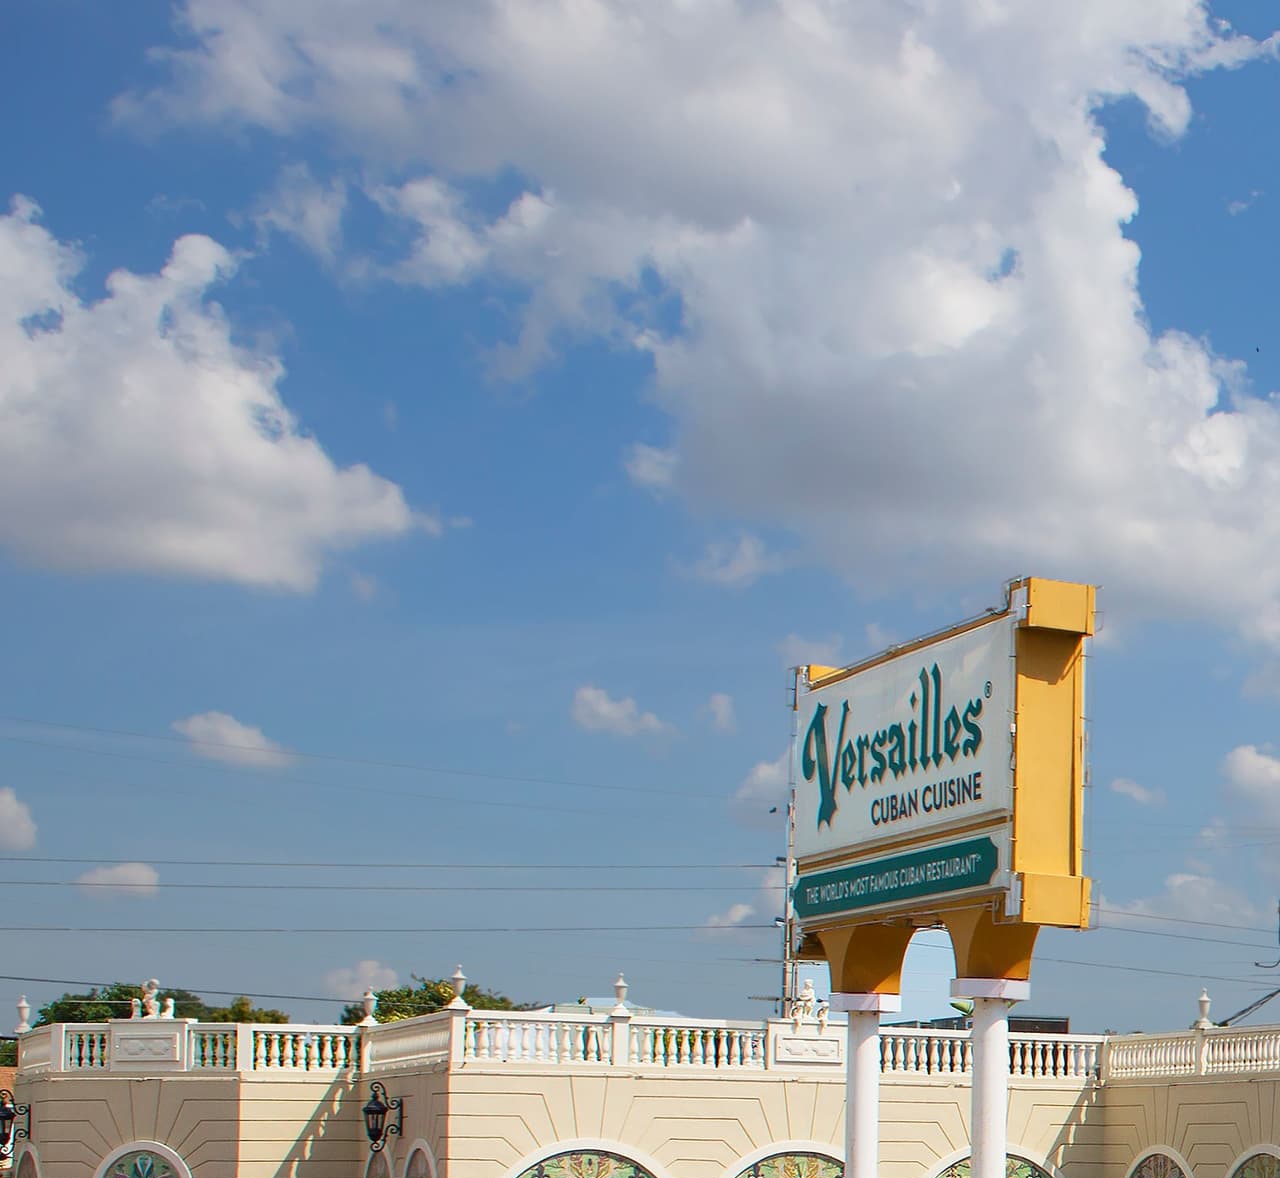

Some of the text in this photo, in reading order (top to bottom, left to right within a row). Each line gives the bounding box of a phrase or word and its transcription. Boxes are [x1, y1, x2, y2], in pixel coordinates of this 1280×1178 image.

[871, 772, 982, 825] CUBAN CUISINE
[805, 887, 819, 904] THE
[819, 881, 849, 902] WORLD'S
[849, 876, 869, 896] MOST
[869, 869, 898, 892] FAMOUS
[898, 866, 925, 887] CUBAN
